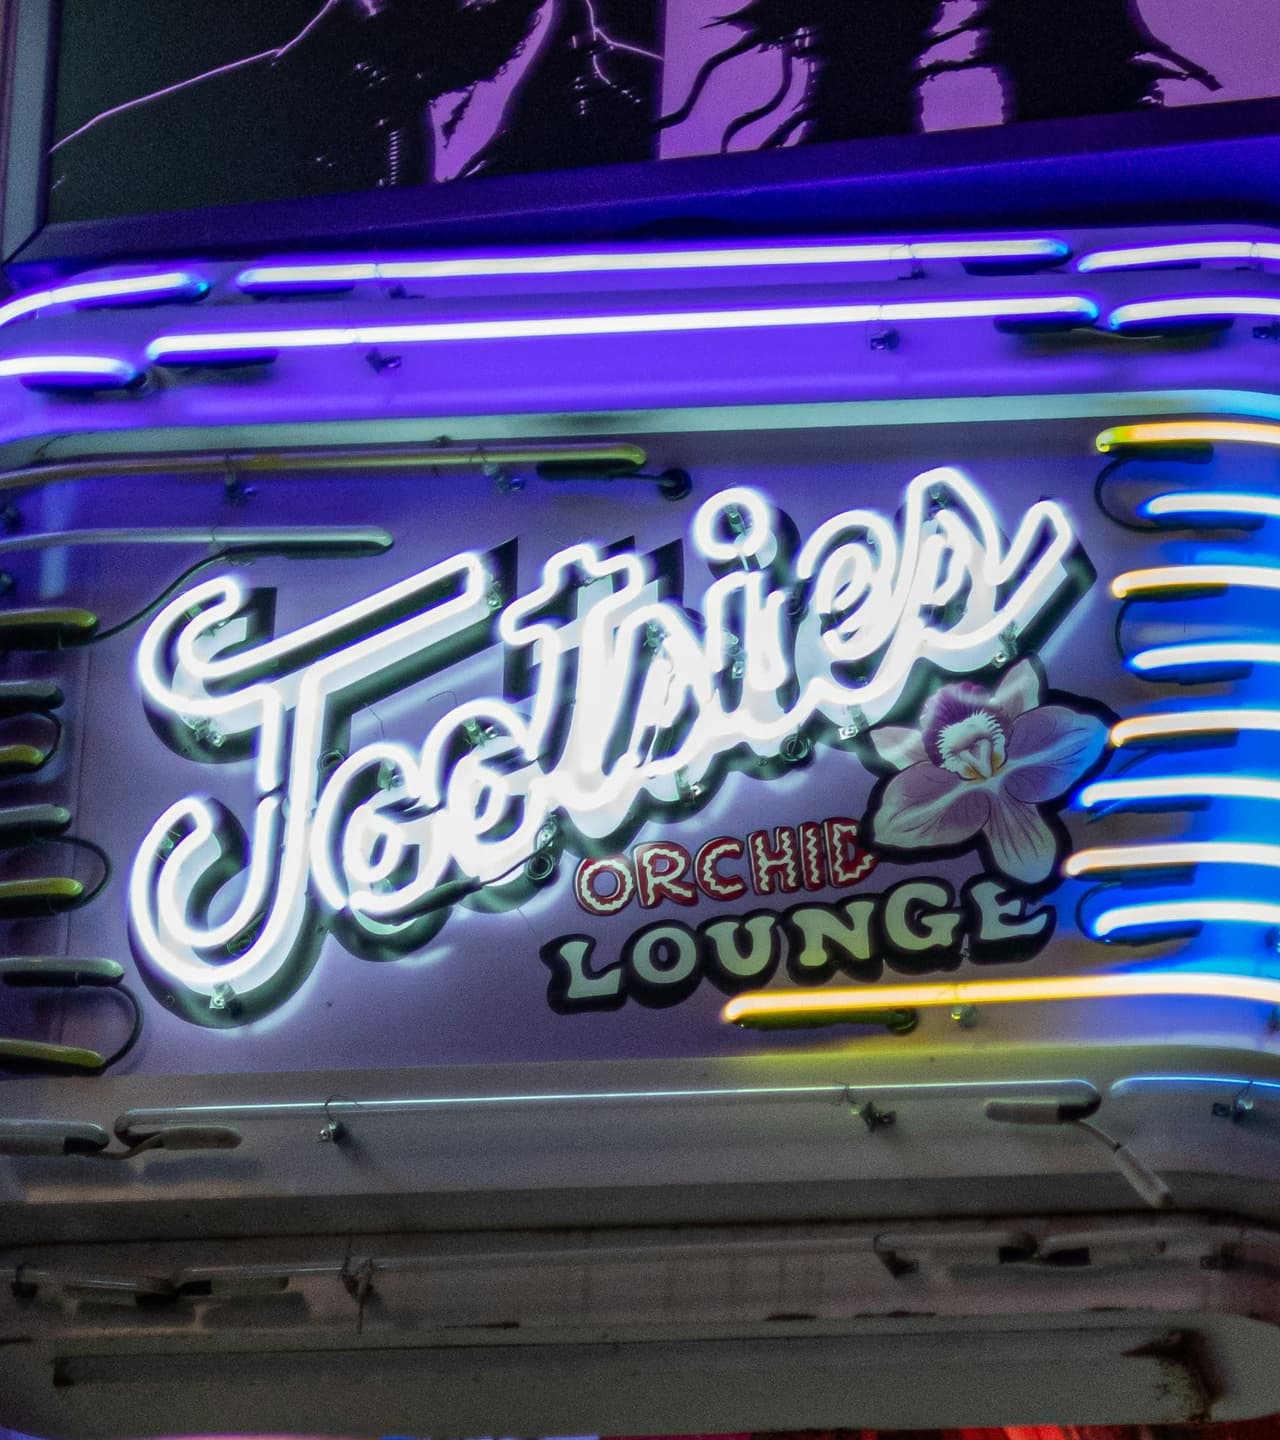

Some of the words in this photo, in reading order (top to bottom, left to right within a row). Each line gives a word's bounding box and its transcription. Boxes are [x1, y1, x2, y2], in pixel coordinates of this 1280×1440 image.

[129, 467, 1075, 992] Tootsies
[573, 818, 880, 915] ORCHID
[548, 880, 1052, 1007] LOUNGE
